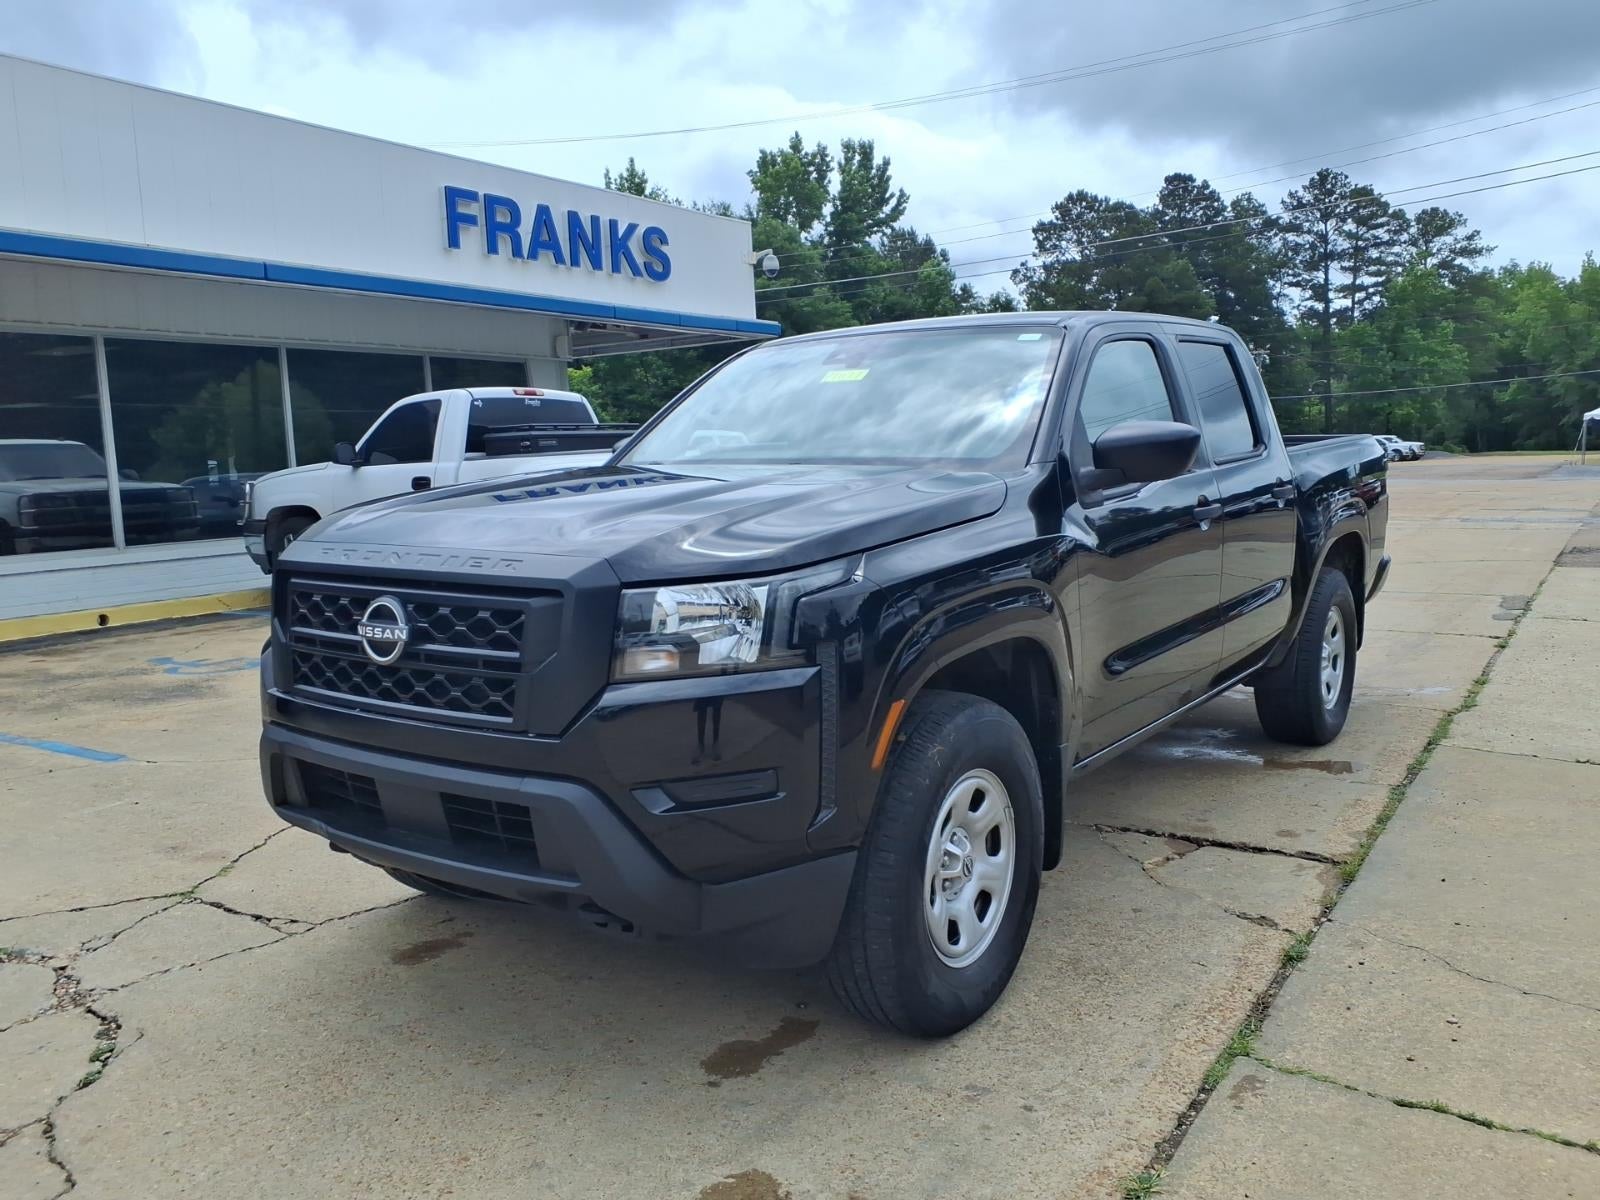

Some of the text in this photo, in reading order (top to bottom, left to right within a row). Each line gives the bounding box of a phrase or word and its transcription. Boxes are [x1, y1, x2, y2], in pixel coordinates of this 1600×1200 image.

[444, 185, 672, 282] FRANKS
[319, 547, 525, 571] FRONTIER
[357, 624, 407, 640] NISSAN
